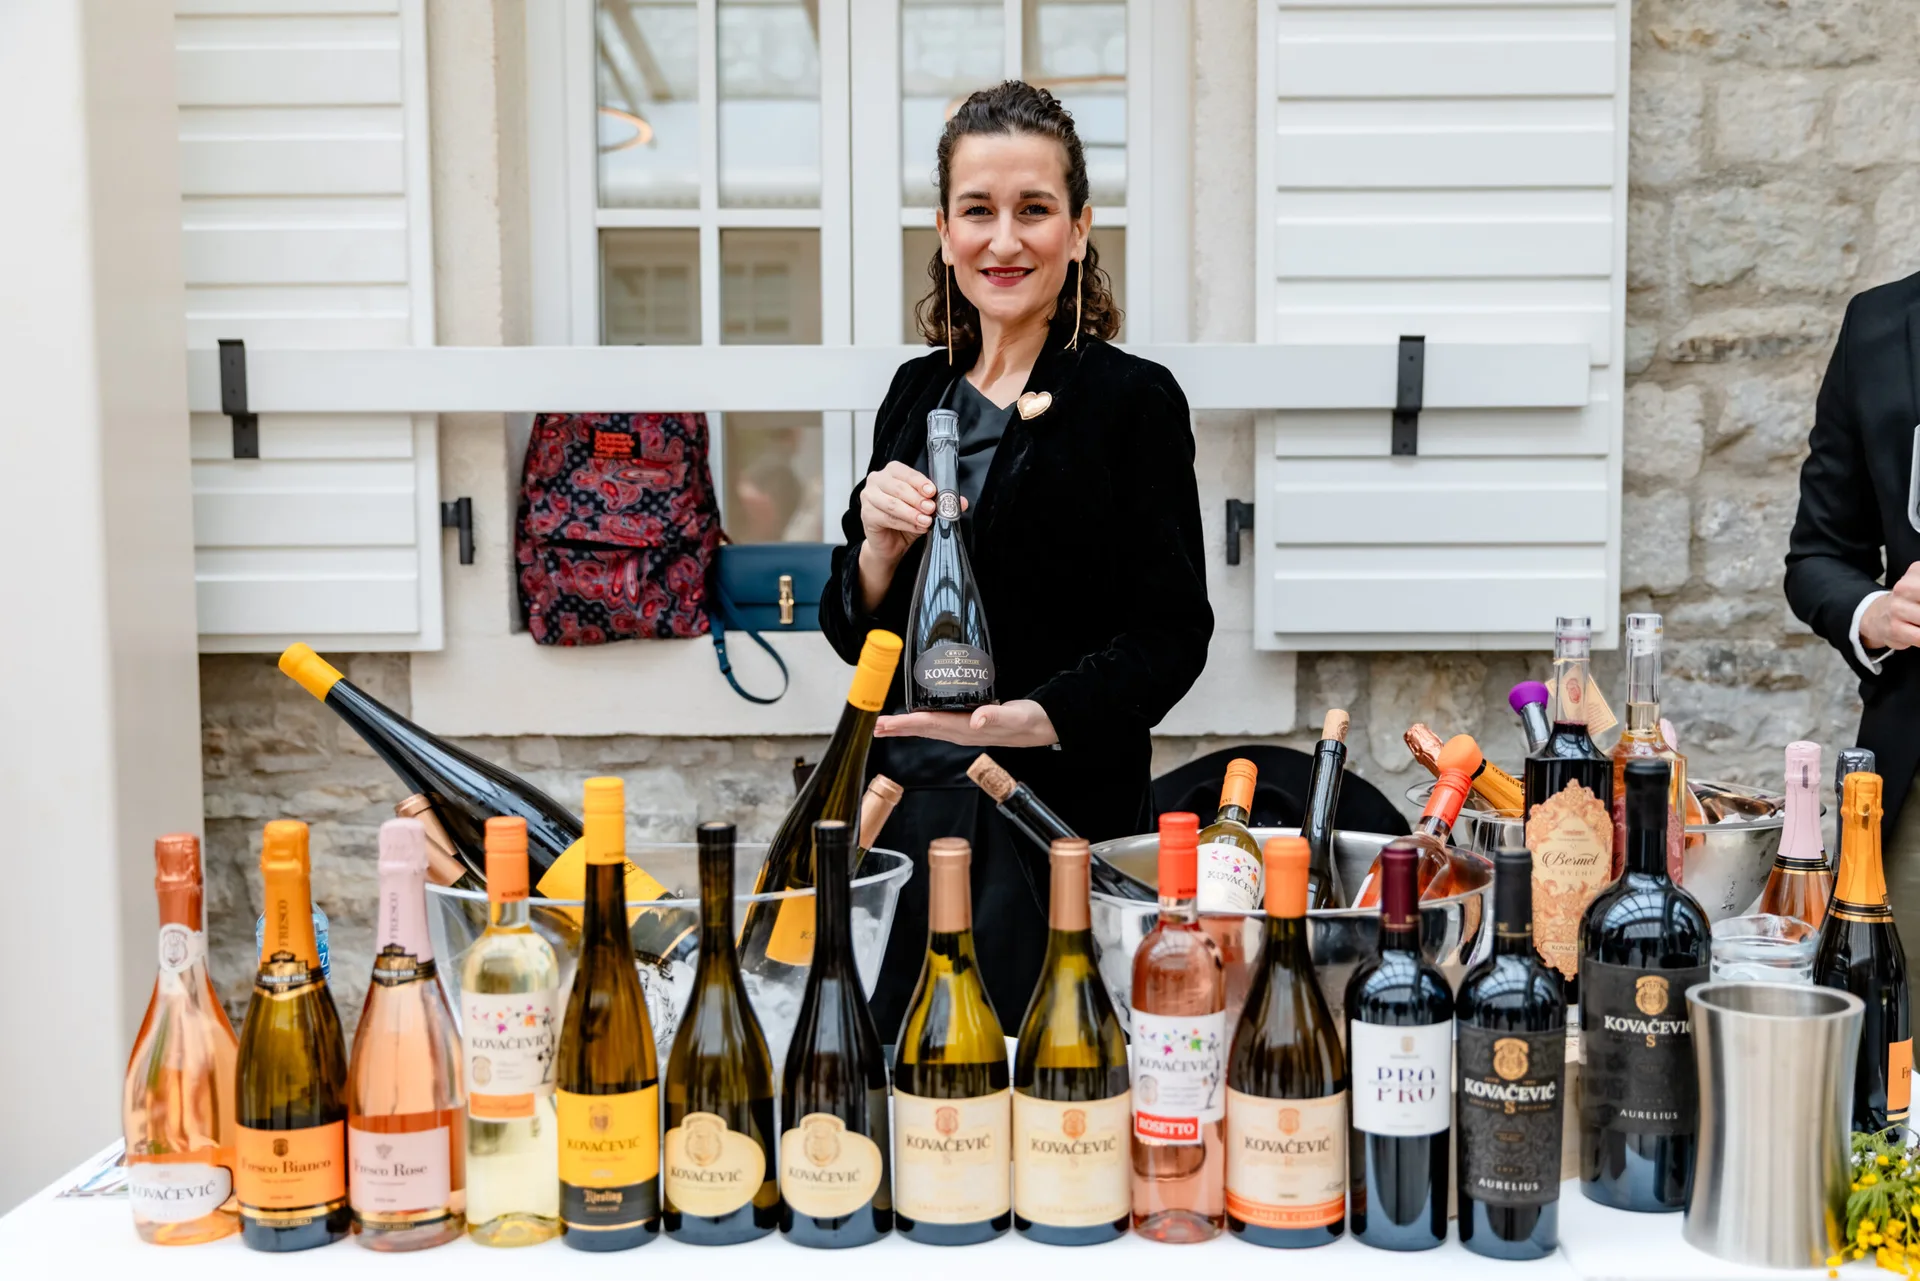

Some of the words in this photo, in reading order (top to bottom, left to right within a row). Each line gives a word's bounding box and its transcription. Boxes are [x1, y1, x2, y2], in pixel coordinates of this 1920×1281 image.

[954, 657, 961, 665] R
[924, 665, 989, 680] KOVAČEVIĆ
[277, 899, 289, 947] FRESCO
[390, 892, 400, 940] FRESCO
[472, 1033, 549, 1050] KOVAČEVIĆ
[1645, 1034, 1656, 1048] S
[1139, 1056, 1213, 1073] KOVAČEVIĆ
[1464, 1078, 1556, 1102] KOVAČEVIĆ
[1504, 1101, 1516, 1115] S
[1620, 1109, 1678, 1121] AURELIUS
[1138, 1117, 1196, 1136] ROSETTO
[567, 1136, 641, 1153] KOVAČEVIĆ
[906, 1132, 991, 1153] KOVAČEVIĆ
[1031, 1137, 1118, 1155] KOVAČEVIĆ
[1244, 1136, 1331, 1155] KOVAČEVIĆ
[242, 1157, 278, 1174] Fresco
[282, 1158, 332, 1174] Bianco
[353, 1158, 388, 1176] Fresco
[393, 1163, 428, 1177] Rose
[670, 1167, 743, 1183] KOVAČEVIĆ
[789, 1167, 861, 1183] KOVAČEVIĆ
[131, 1181, 217, 1201] KOVAČEVIĆ
[1478, 1178, 1540, 1191] AURELIUS
